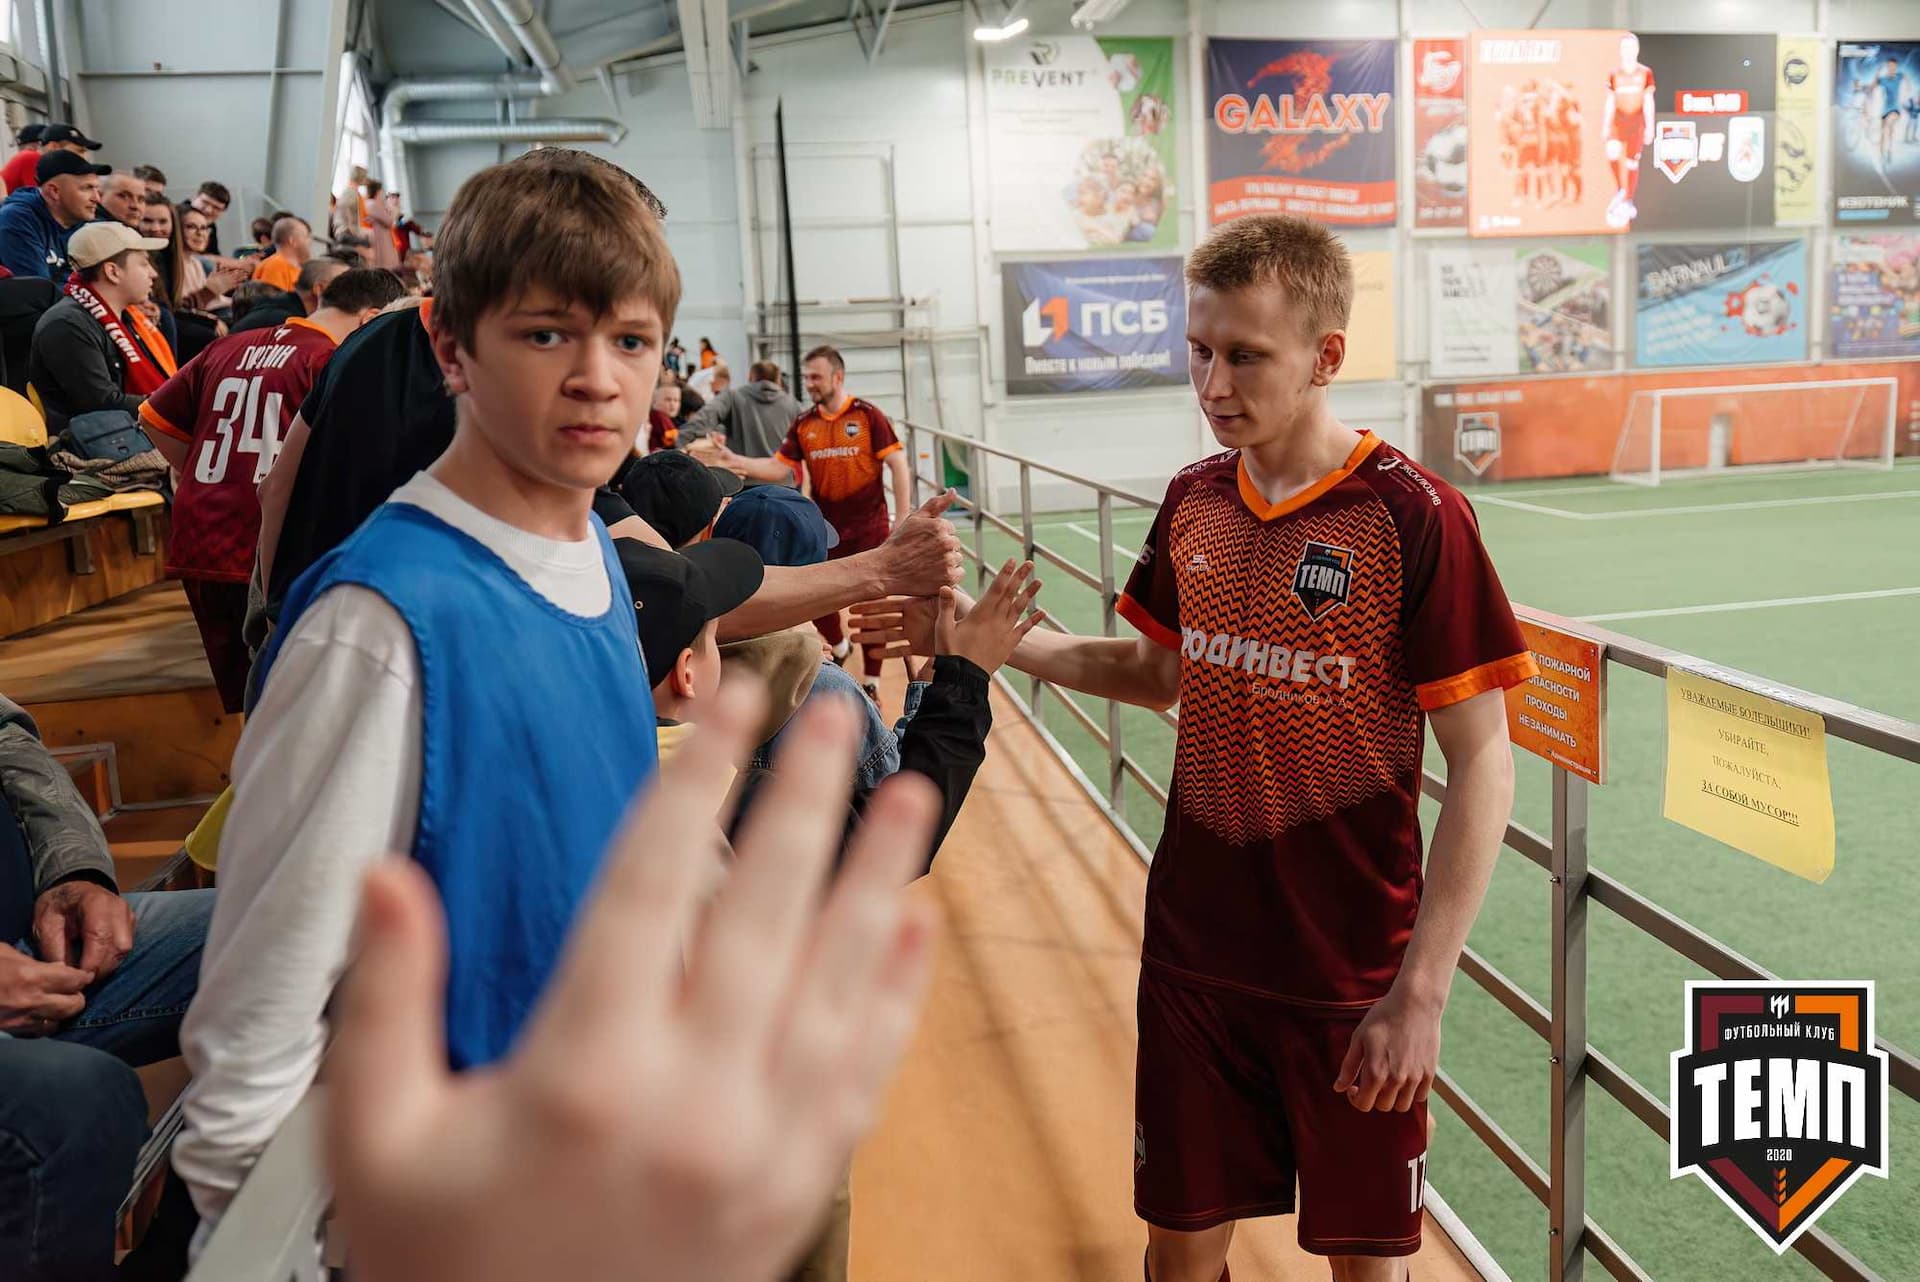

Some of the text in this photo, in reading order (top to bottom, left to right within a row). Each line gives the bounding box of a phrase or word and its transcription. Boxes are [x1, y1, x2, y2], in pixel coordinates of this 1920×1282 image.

[991, 68, 1086, 88] PREVENT
[1215, 93, 1391, 135] GALAXY
[1081, 300, 1168, 337] ПСБ
[195, 376, 284, 484] 34
[1399, 463, 1441, 506] ЭКСКЛЮЗИВ
[1300, 564, 1346, 598] ТЕМП
[1538, 654, 1591, 682] ПОЖАРНОЙ
[1252, 682, 1320, 705] Бродников
[1528, 675, 1580, 702] ОПАСНОСТИ
[1525, 694, 1568, 721] ПРОХОДЫ
[1680, 687, 1811, 738] УВАЖАЕМЫЕ БОЛЕЛЬЩИКИ!
[1718, 728, 1769, 756] УБИРАЙТЕ,
[1712, 755, 1782, 790] ПОЖАЛУЙСТА,
[1701, 779, 1799, 825] ЗА СОБОЙ МУСОР!!!
